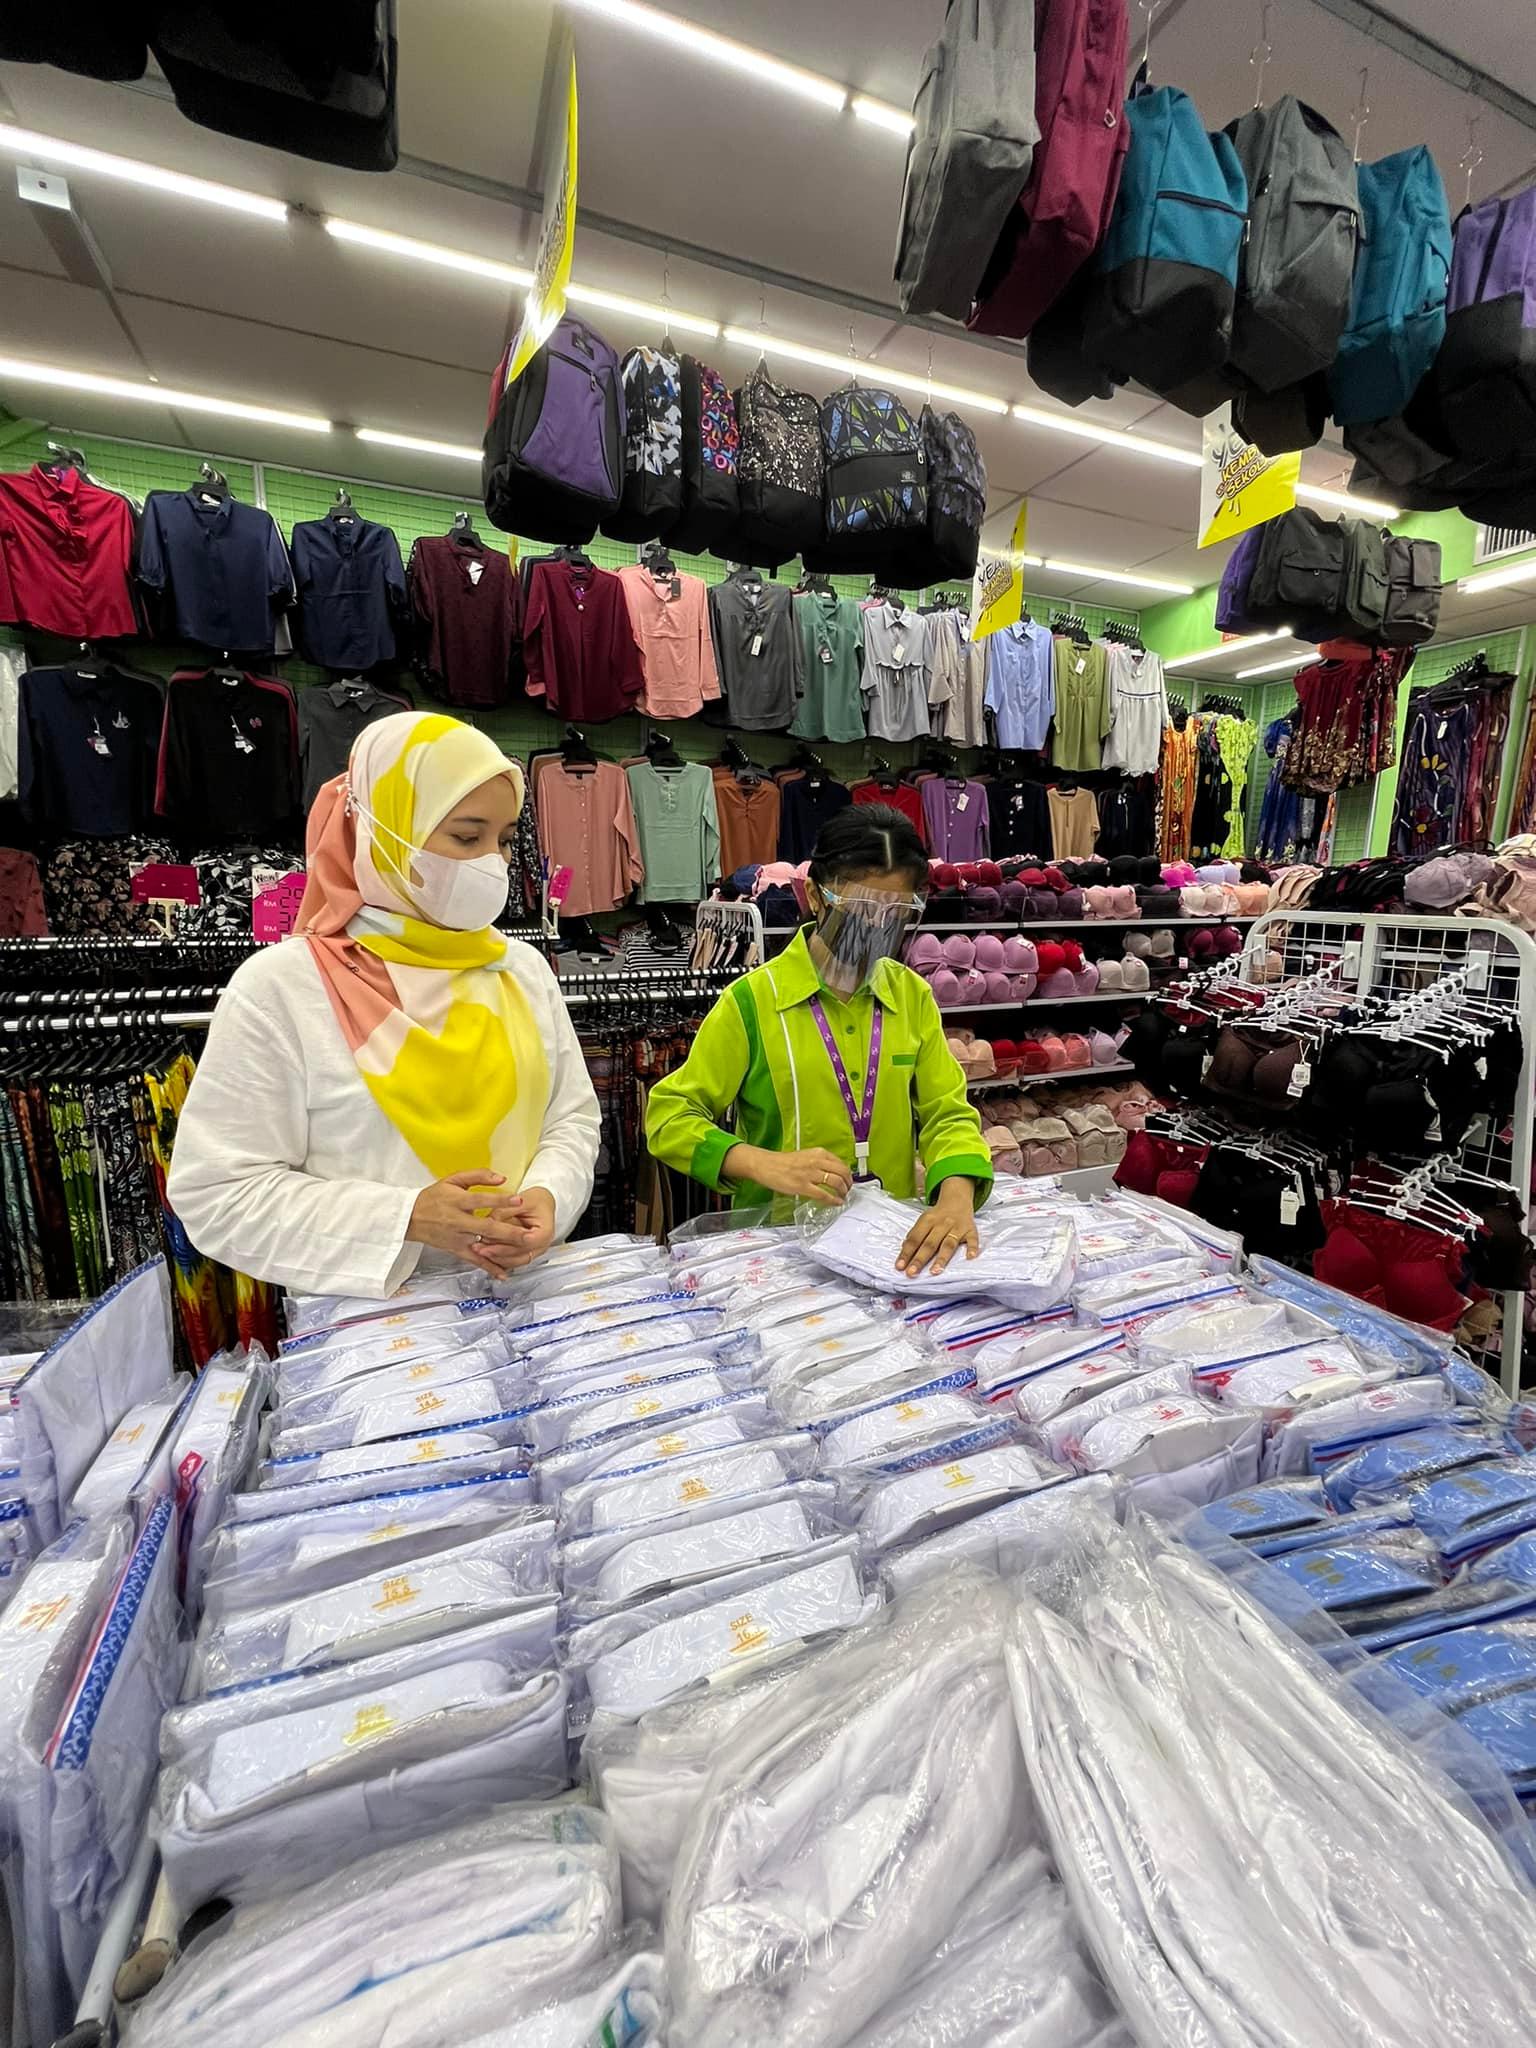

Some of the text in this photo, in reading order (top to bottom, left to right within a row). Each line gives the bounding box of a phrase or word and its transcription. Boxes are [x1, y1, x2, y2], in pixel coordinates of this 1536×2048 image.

[263, 899, 277, 907] RM
[263, 925, 277, 933] RM
[730, 1613, 752, 1631] SIZE
